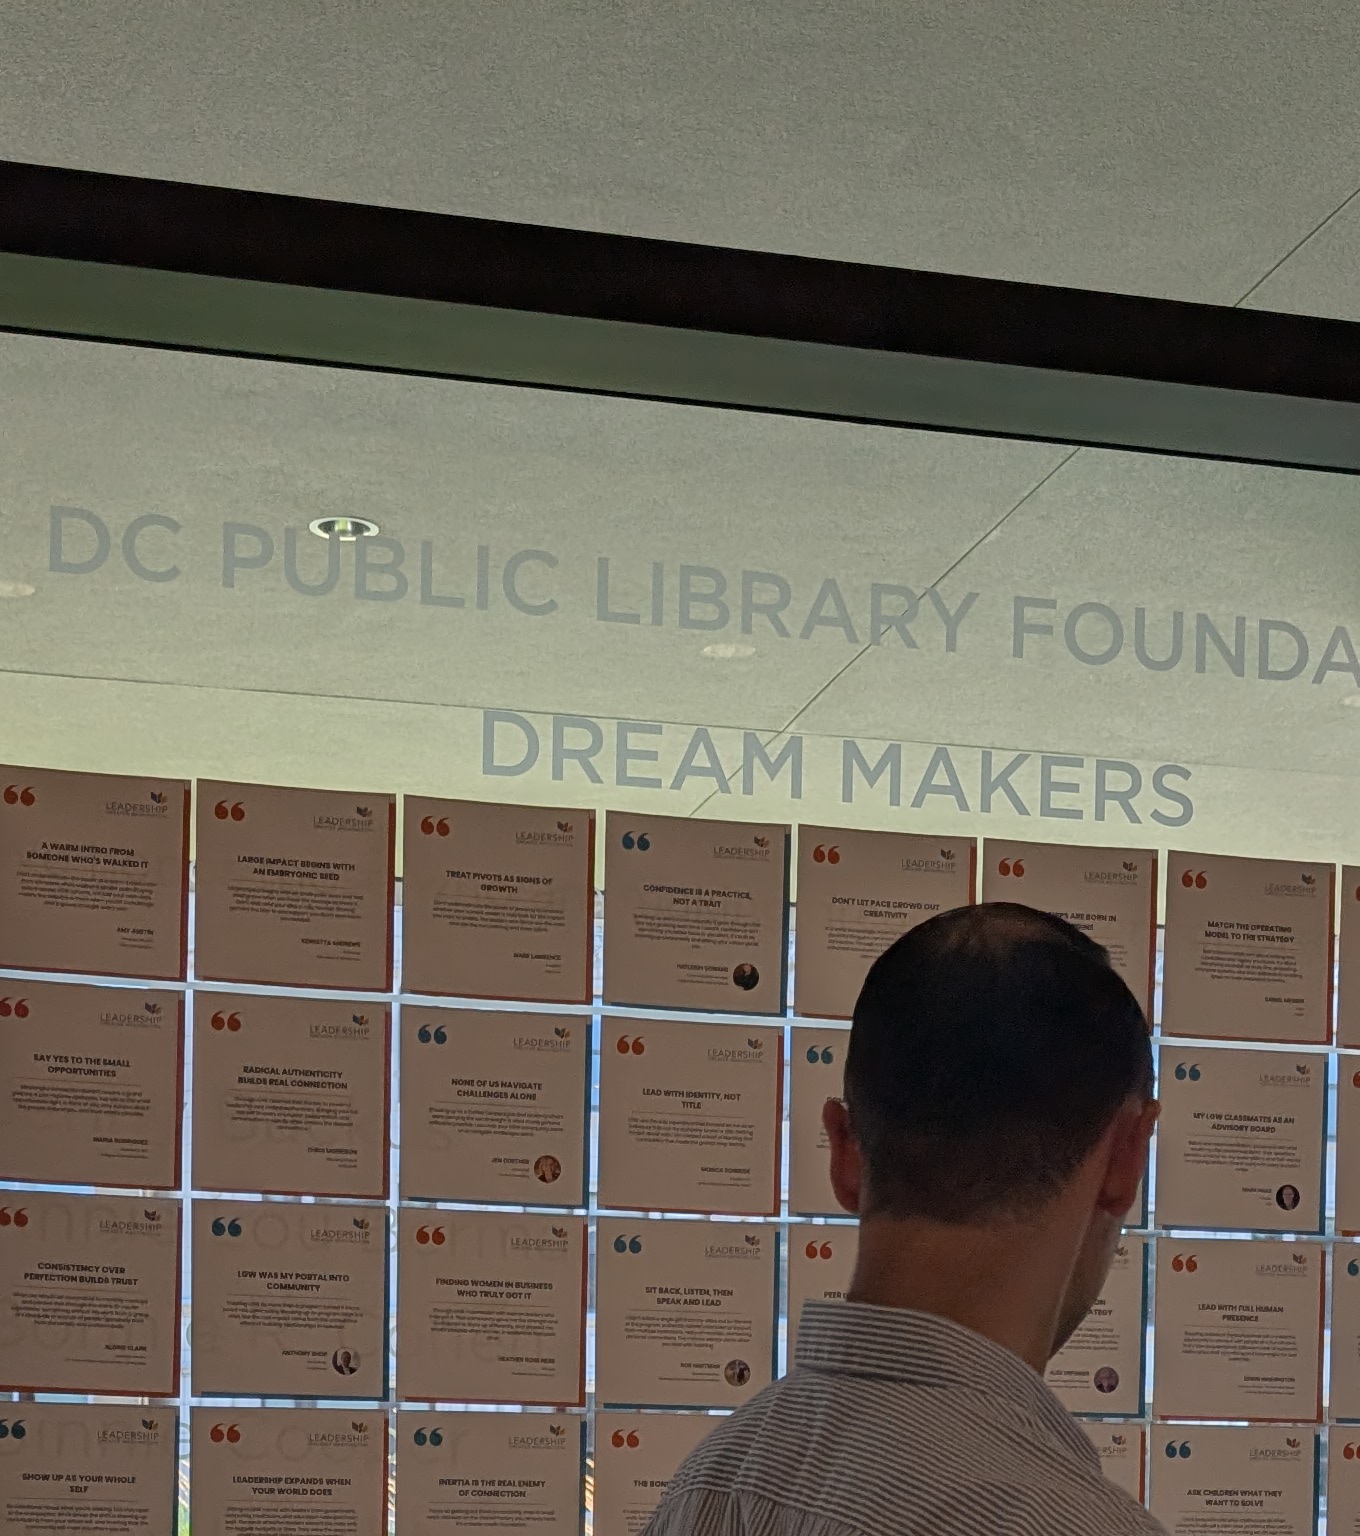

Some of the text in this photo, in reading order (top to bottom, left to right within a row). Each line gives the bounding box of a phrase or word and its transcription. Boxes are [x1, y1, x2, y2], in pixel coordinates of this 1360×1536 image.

[48, 505, 182, 583] DC
[222, 521, 559, 616] PUBLIC
[595, 556, 980, 652] LIBRARY
[481, 708, 1193, 828] DREAM MAKERS
[49, 842, 79, 852] WARM
[80, 844, 108, 854] INTRO
[108, 846, 135, 856] FROM
[25, 851, 70, 862] SOMEONE
[70, 854, 101, 865] WHO'S
[102, 857, 139, 868] WALKED
[445, 870, 471, 880] TREAT
[471, 871, 502, 882] PIVOTS
[515, 874, 540, 884] SIGNS
[479, 883, 518, 893] GROWTH
[32, 1053, 51, 1063] SAY
[52, 1054, 69, 1064] YES
[84, 1056, 101, 1065] THE
[102, 1057, 130, 1067] SMALL
[46, 1065, 116, 1077] OPPORTUNITIES
[242, 1065, 342, 1078] RADICAL AUTHENTICITY
[236, 1076, 348, 1089] BUILDS REAL CONNECTION
[36, 1262, 125, 1274] CONSISTENCY OVER
[23, 1272, 137, 1285] PERFECTION BUILDS TRUST
[644, 1285, 733, 1297] SIT BACK, LISTEN, THEN
[656, 1296, 721, 1306] SPEAK AND LEAD
[231, 1475, 351, 1485] LEADERSHIP EXPANDS WHEN
[251, 1486, 332, 1496] YOUR WORLD DOES
